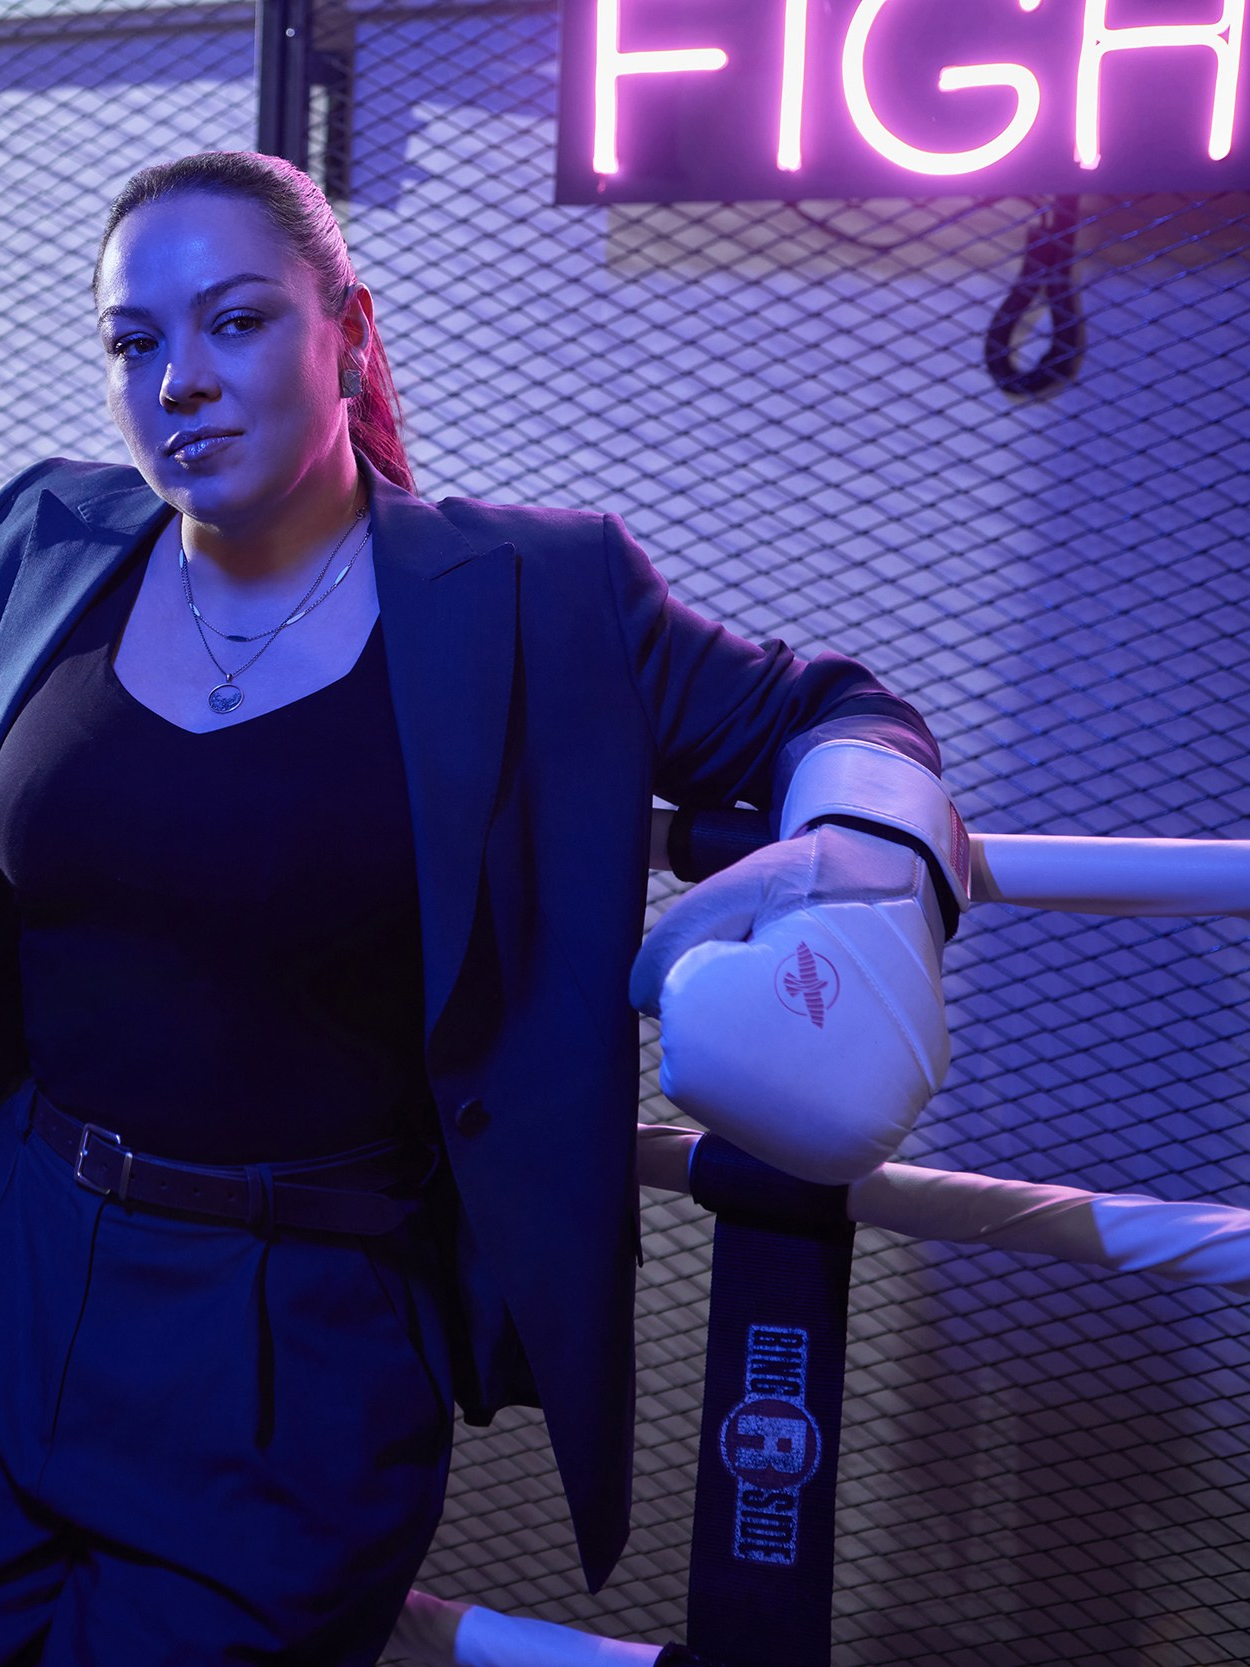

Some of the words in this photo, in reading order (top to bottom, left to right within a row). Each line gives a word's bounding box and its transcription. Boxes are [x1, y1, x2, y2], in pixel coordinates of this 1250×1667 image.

[593, 0, 1246, 175] FIGH
[750, 1329, 804, 1397] RING
[734, 1414, 808, 1475] R
[737, 1488, 796, 1560] SIDE
